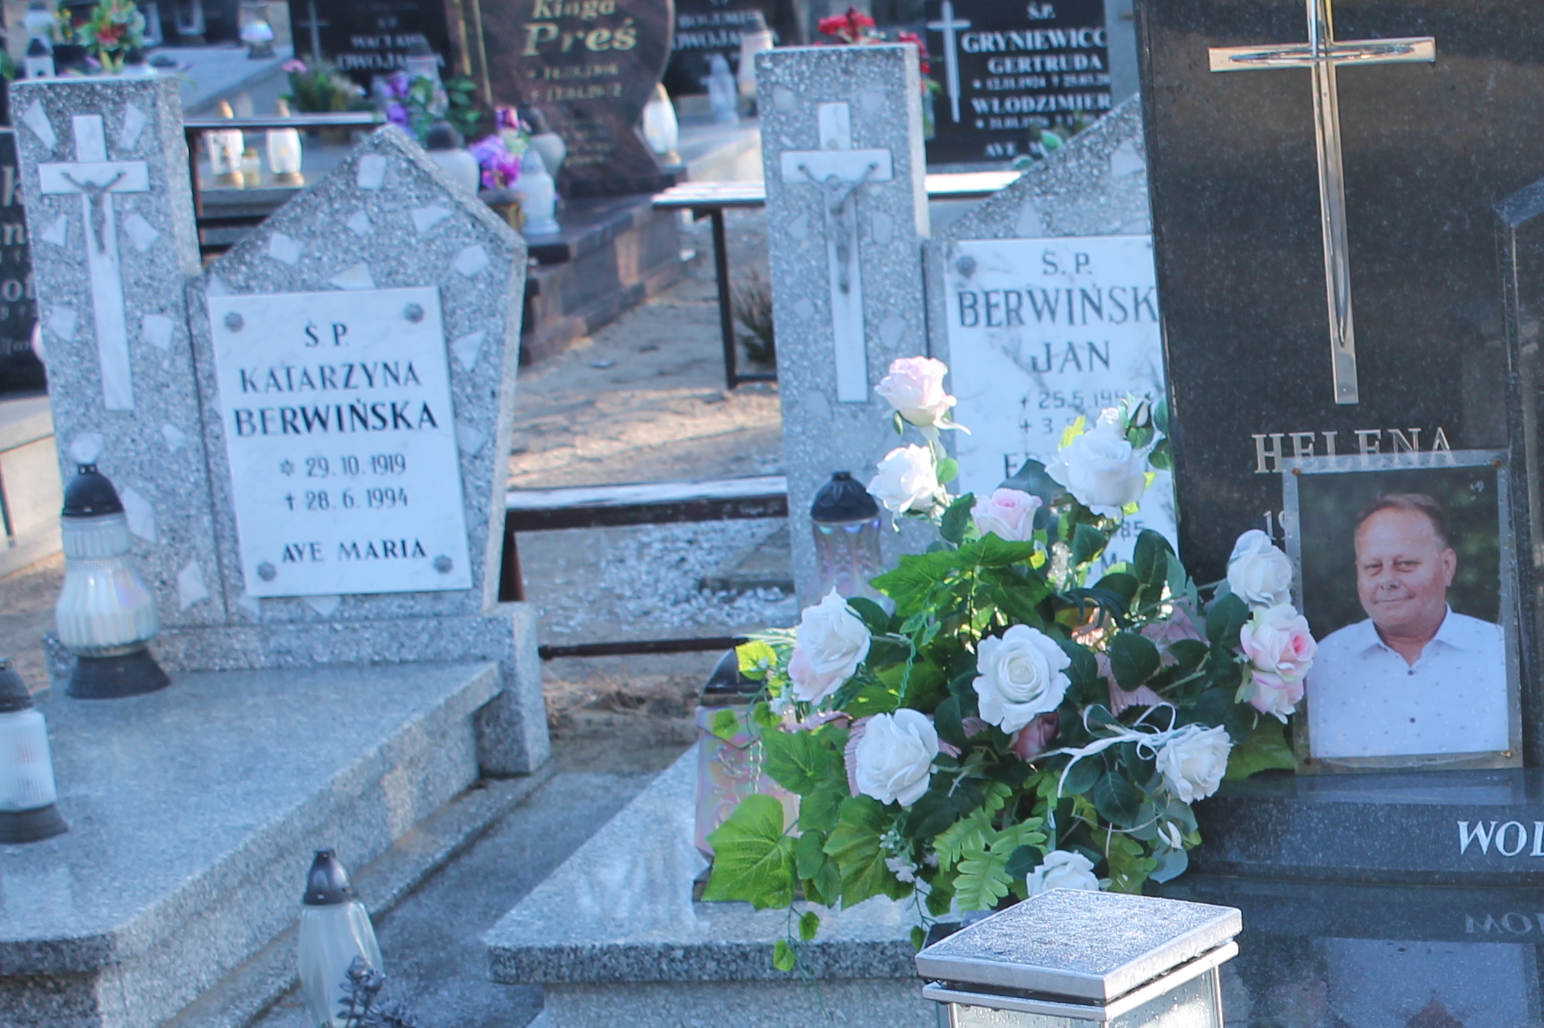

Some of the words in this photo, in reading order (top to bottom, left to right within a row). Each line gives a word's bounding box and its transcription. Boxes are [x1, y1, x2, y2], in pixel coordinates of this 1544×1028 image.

[520, 17, 637, 56] Preś
[987, 54, 1103, 75] GERTRUDA
[1031, 340, 1111, 374] JAN
[239, 361, 421, 394] KATARZYNA
[233, 398, 439, 437] BERWIŃSKA
[1251, 426, 1456, 473] HELENA
[282, 542, 324, 564] AVE
[338, 538, 428, 562] MARIA
